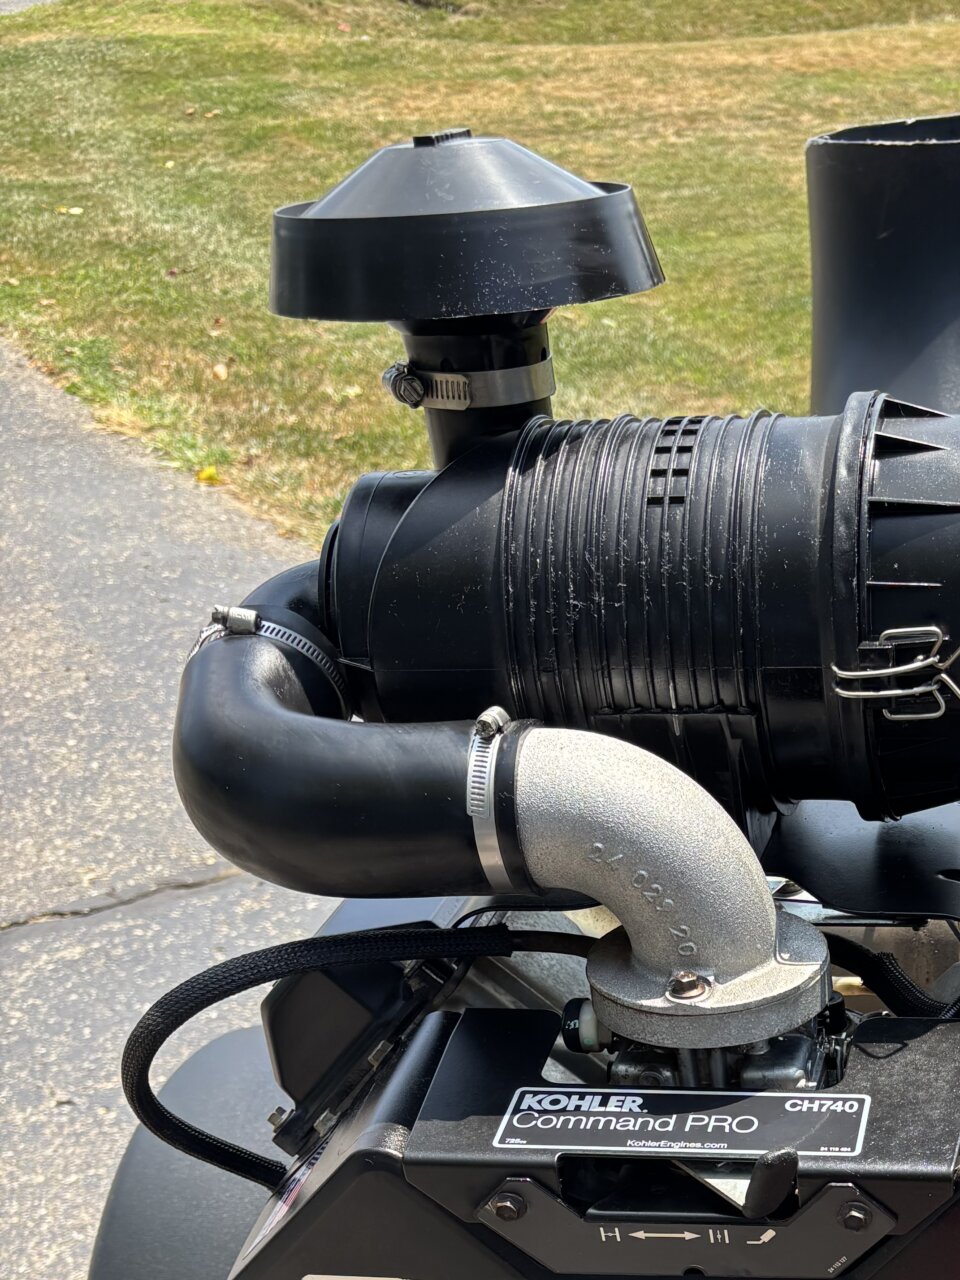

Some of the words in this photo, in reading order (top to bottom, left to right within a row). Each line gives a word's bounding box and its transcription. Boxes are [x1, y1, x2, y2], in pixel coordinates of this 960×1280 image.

[784, 1099, 859, 1114] CH740
[512, 1111, 673, 1132] Command
[684, 1115, 759, 1134] PRO
[627, 1139, 728, 1150] KohlerEngines.com
